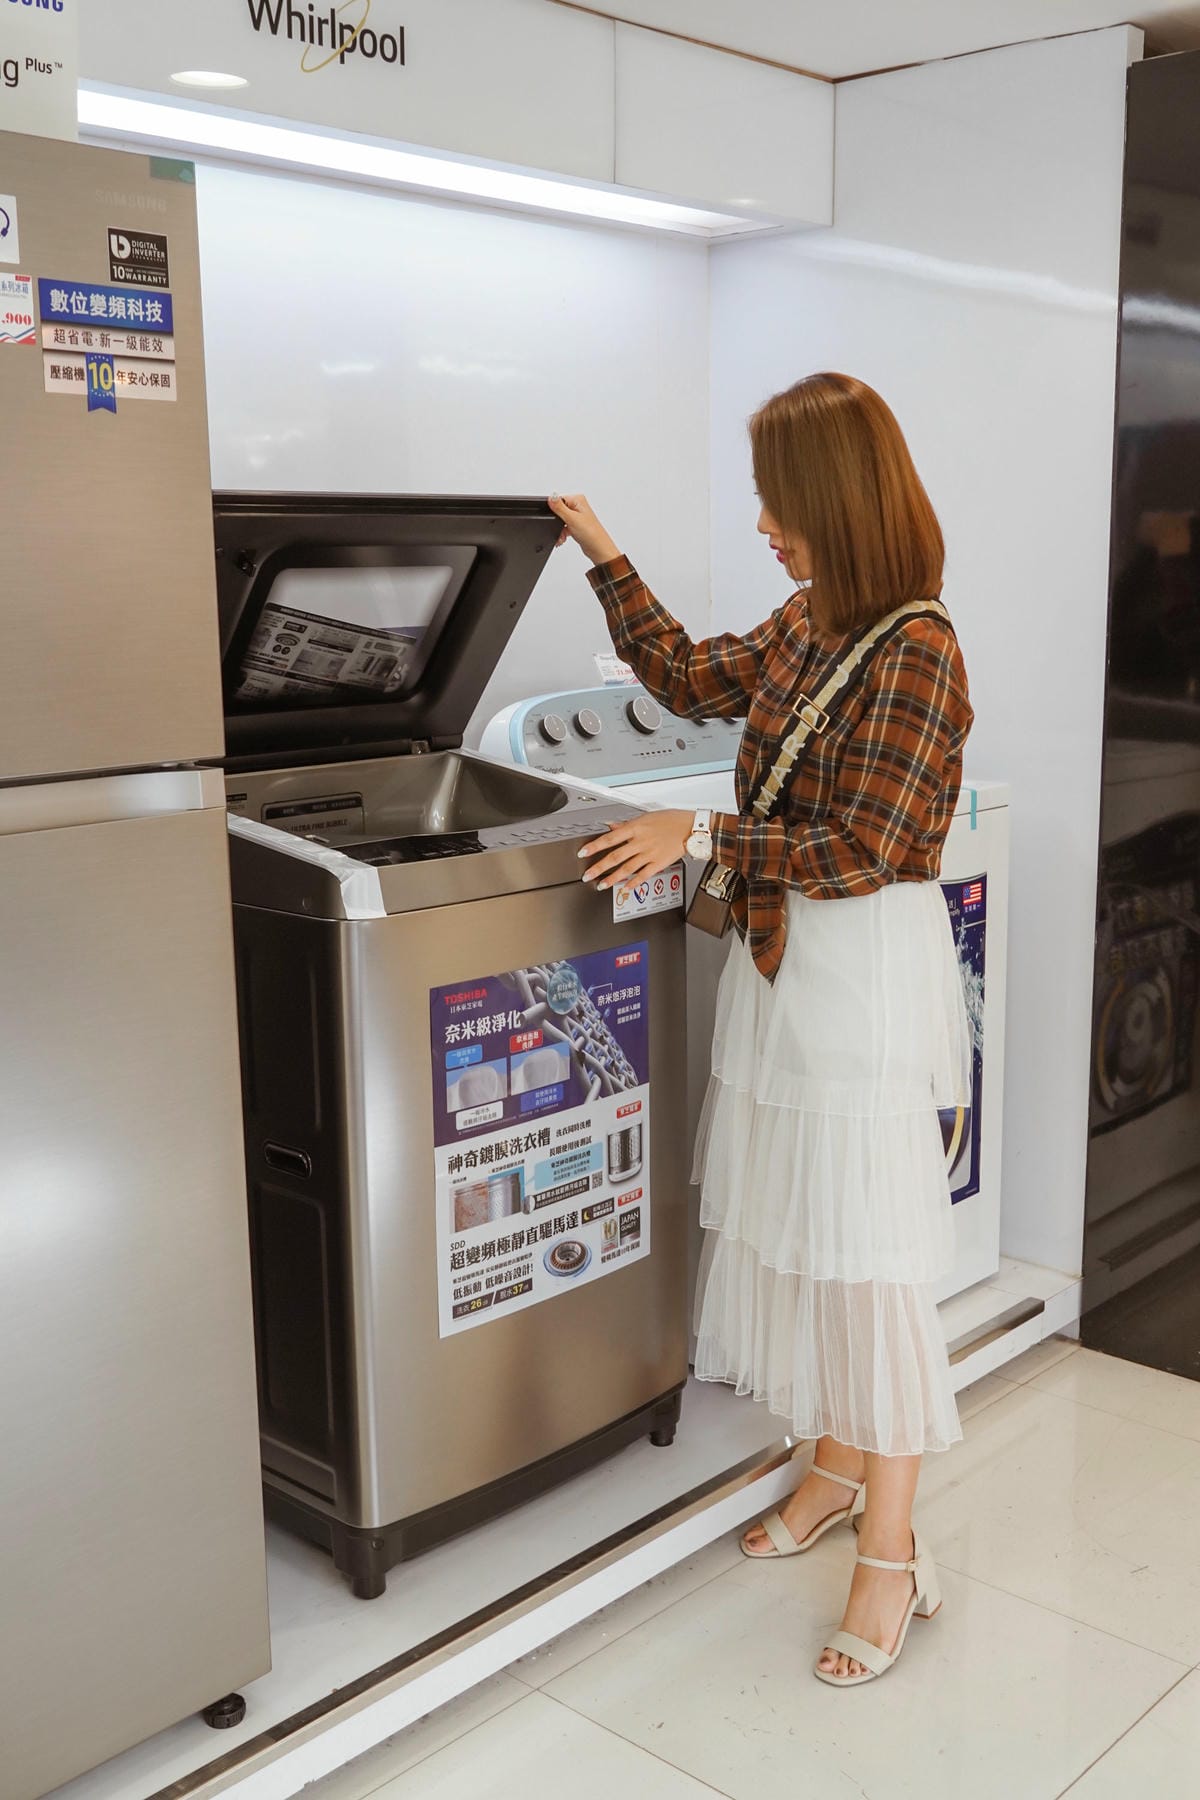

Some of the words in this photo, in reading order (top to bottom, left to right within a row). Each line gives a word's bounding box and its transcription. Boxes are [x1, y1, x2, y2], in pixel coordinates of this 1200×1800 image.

[247, 0, 405, 66] Whirlpool
[0, 59, 19, 87] g
[131, 240, 158, 250] DIGITAL
[132, 247, 165, 258] INVERTER
[112, 265, 125, 279] 10
[125, 273, 167, 284] WARRANTY
[49, 288, 164, 323] 數位變頻科技
[444, 988, 488, 1005] TOSHIBA
[444, 1009, 521, 1044] 奈米級淨化
[447, 1127, 550, 1175] 神奇鍍膜洗衣槽
[620, 1211, 639, 1226] JAPAN
[450, 1211, 578, 1272] 超變頻極靜直驅馬達
[450, 1239, 466, 1251] SDD
[453, 1280, 482, 1300] 低振動
